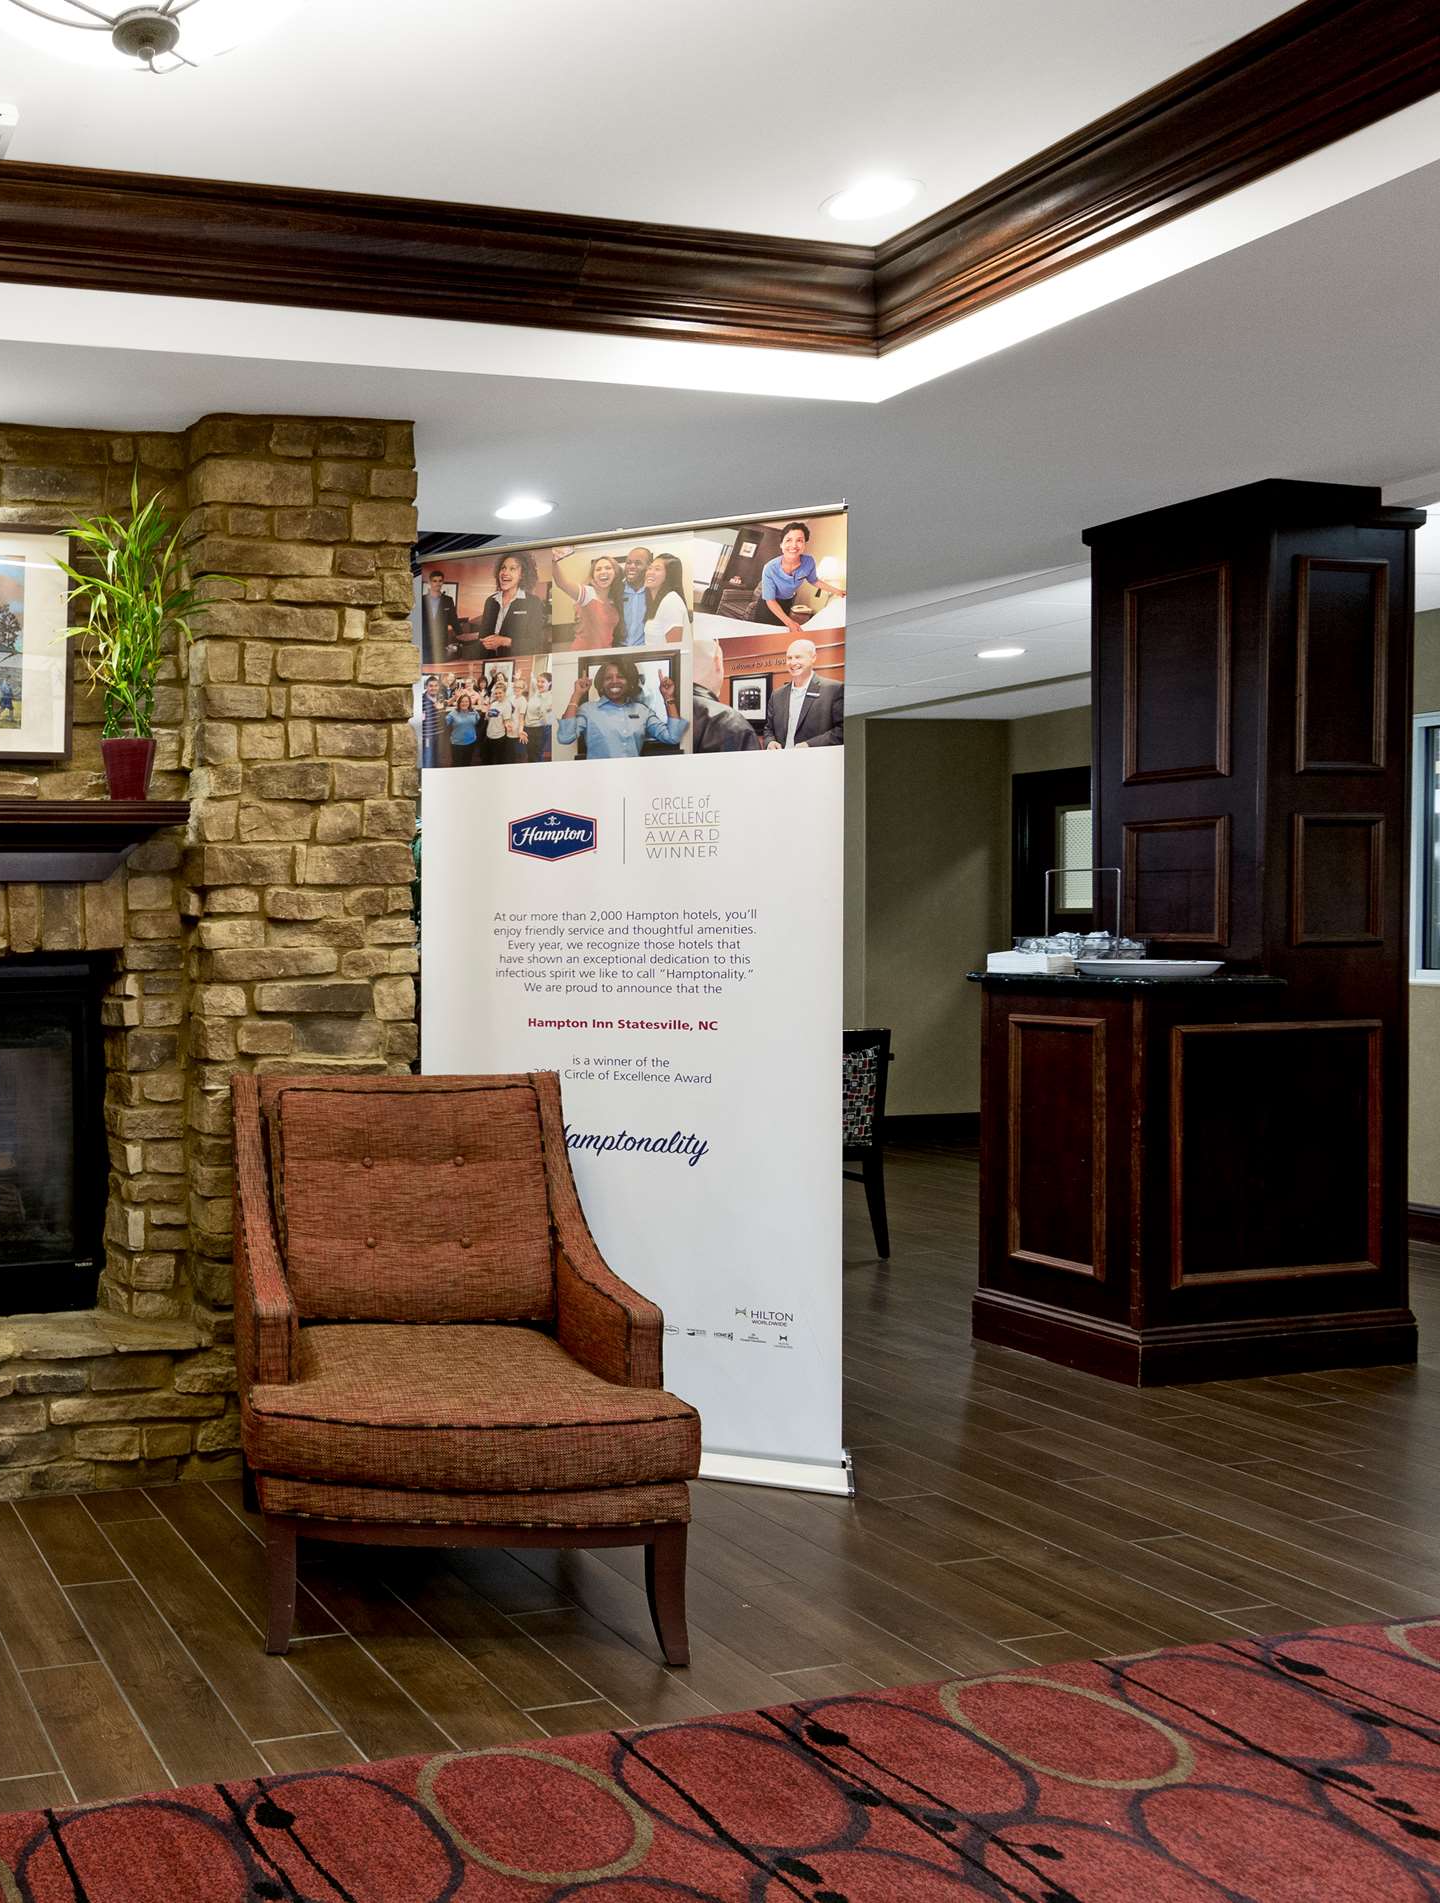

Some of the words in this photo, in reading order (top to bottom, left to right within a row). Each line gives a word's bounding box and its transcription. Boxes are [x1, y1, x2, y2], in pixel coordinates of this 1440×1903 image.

[652, 796, 694, 811] CIRCLE
[698, 795, 711, 810] of
[644, 810, 720, 826] EXCELLENCE
[512, 826, 593, 847] Hampton
[645, 829, 720, 843] AWARD
[646, 845, 720, 859] WINNER
[494, 913, 506, 921] At
[531, 912, 558, 921] more
[562, 911, 586, 921] than
[590, 911, 622, 922] 2,000
[627, 911, 679, 922] Hampton
[683, 909, 720, 920] hotels,
[725, 909, 756, 922] you'll
[494, 928, 521, 937] enjoy
[525, 925, 565, 937] friendly
[608, 924, 628, 935] and
[633, 924, 693, 937] thoughtful
[697, 924, 756, 934] amenities.
[508, 940, 535, 952] Every
[539, 942, 562, 952] year,
[587, 940, 640, 952] recognize
[644, 939, 674, 949] those
[679, 939, 713, 949] hotels
[717, 939, 740, 949] that
[500, 954, 524, 963] have
[528, 954, 562, 963] shown
[583, 953, 646, 966] exceptional
[650, 954, 709, 964] dedication
[714, 956, 726, 964] to
[730, 954, 750, 964] this
[496, 968, 546, 978] infectious
[550, 968, 575, 980] spirit
[579, 968, 595, 978] we
[600, 968, 618, 978] like
[622, 970, 633, 978] to
[637, 968, 655, 978] call
[524, 983, 542, 992] We
[566, 983, 597, 995] proud
[602, 984, 613, 992] to
[617, 985, 672, 993] announce
[676, 983, 699, 993] that
[704, 984, 722, 994] the
[528, 1017, 588, 1030] Hampton
[593, 1019, 613, 1028] Inn
[618, 1020, 693, 1031] Statesville,
[698, 1021, 719, 1031] NC
[572, 1054, 580, 1065] is
[593, 1055, 632, 1066] winner
[636, 1055, 648, 1067] of
[650, 1056, 670, 1068] the
[565, 1069, 594, 1080] Circle
[598, 1070, 610, 1080] of
[614, 1071, 670, 1082] Excellence
[674, 1073, 712, 1083] Award
[563, 1124, 709, 1167] amptonality
[751, 1310, 794, 1323] HILTON
